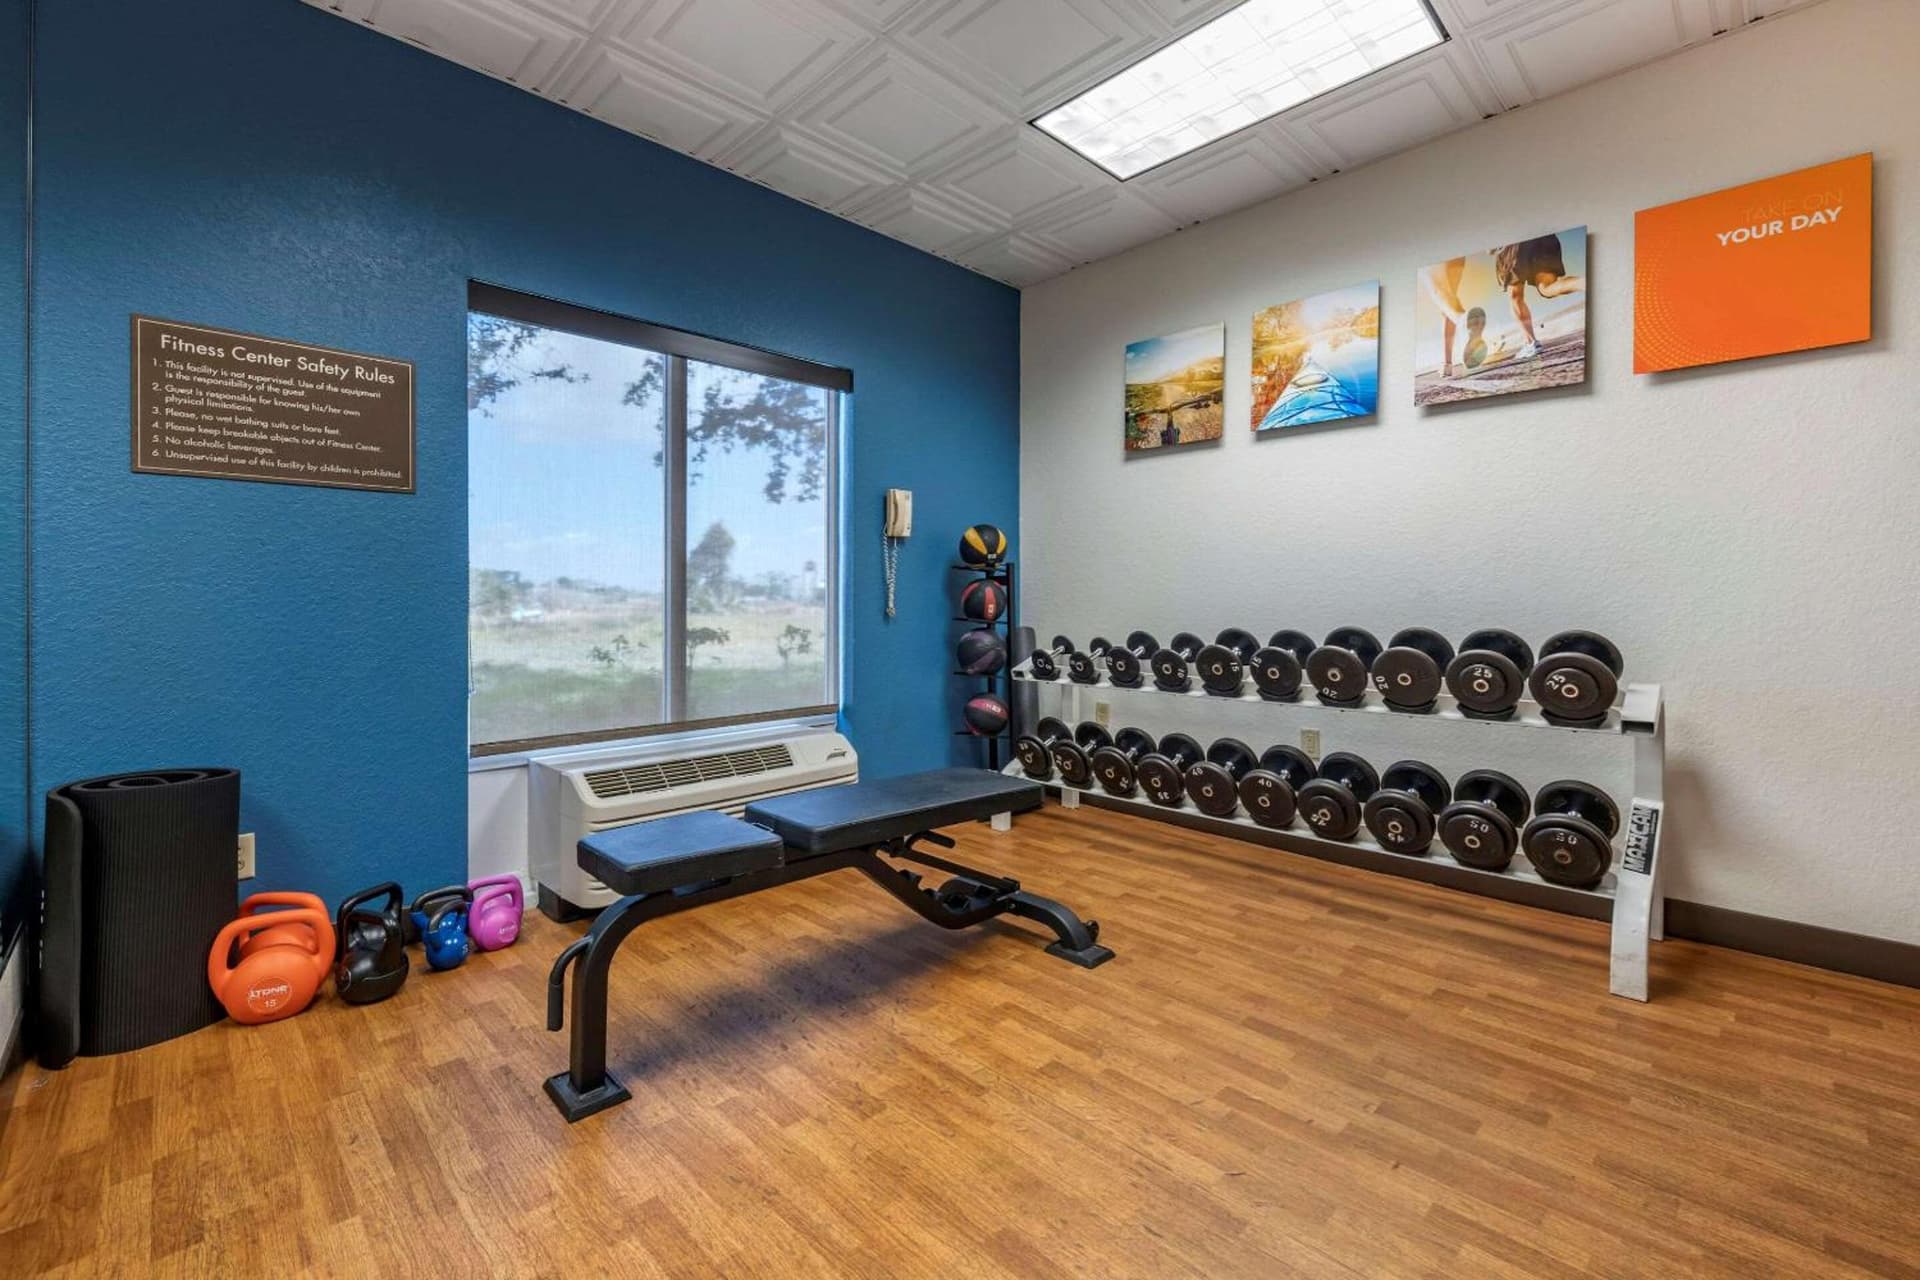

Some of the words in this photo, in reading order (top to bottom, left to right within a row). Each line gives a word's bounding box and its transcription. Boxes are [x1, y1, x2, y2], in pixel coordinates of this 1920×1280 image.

[1742, 198, 1794, 222] TAKE
[1803, 189, 1843, 209] ON
[1716, 219, 1784, 246] YOUR
[1791, 206, 1842, 231] DAY
[161, 334, 225, 358] Fitness
[231, 346, 291, 367] Center
[297, 356, 350, 380] Safety
[355, 365, 395, 384] Rules
[165, 360, 184, 371] This
[186, 362, 218, 376] facility
[221, 368, 228, 376] is
[230, 371, 245, 379] not
[248, 374, 295, 386] supervised.
[298, 380, 314, 389] Use
[316, 382, 325, 390] of
[326, 383, 339, 393] the
[340, 388, 381, 399] equipment
[175, 371, 190, 381] the
[193, 376, 253, 391] responsibility
[255, 383, 265, 391] of
[266, 384, 280, 393] the
[165, 384, 193, 395] Guest
[195, 387, 203, 396] is
[205, 390, 257, 403] responsible
[259, 395, 272, 405] for
[274, 398, 310, 412] knowing
[311, 402, 341, 414] his/her
[165, 394, 204, 406] physical
[165, 407, 199, 420] Please,
[215, 415, 233, 423] wet
[234, 415, 269, 429] bathing
[271, 421, 289, 430] suits
[303, 423, 322, 434] bare
[165, 421, 196, 432] Please
[198, 424, 221, 437] keep
[223, 427, 268, 440] breakable
[269, 432, 300, 444] objects
[301, 438, 315, 446] out
[317, 439, 325, 447] of
[327, 439, 354, 450] Fitness
[165, 436, 182, 445] No
[183, 437, 225, 449] alcoholic
[165, 450, 229, 463] Unsupervised
[230, 457, 246, 465] use
[248, 456, 258, 466] of
[259, 457, 275, 468] this
[277, 459, 305, 472] facility
[307, 461, 318, 472] by
[320, 463, 352, 474] children
[353, 467, 360, 475] is
[1375, 675, 1389, 690] 20
[1473, 667, 1493, 679] 25
[1546, 674, 1566, 690] 25
[1322, 687, 1338, 699] 20
[1257, 778, 1273, 789] 40
[1469, 819, 1490, 833] 50
